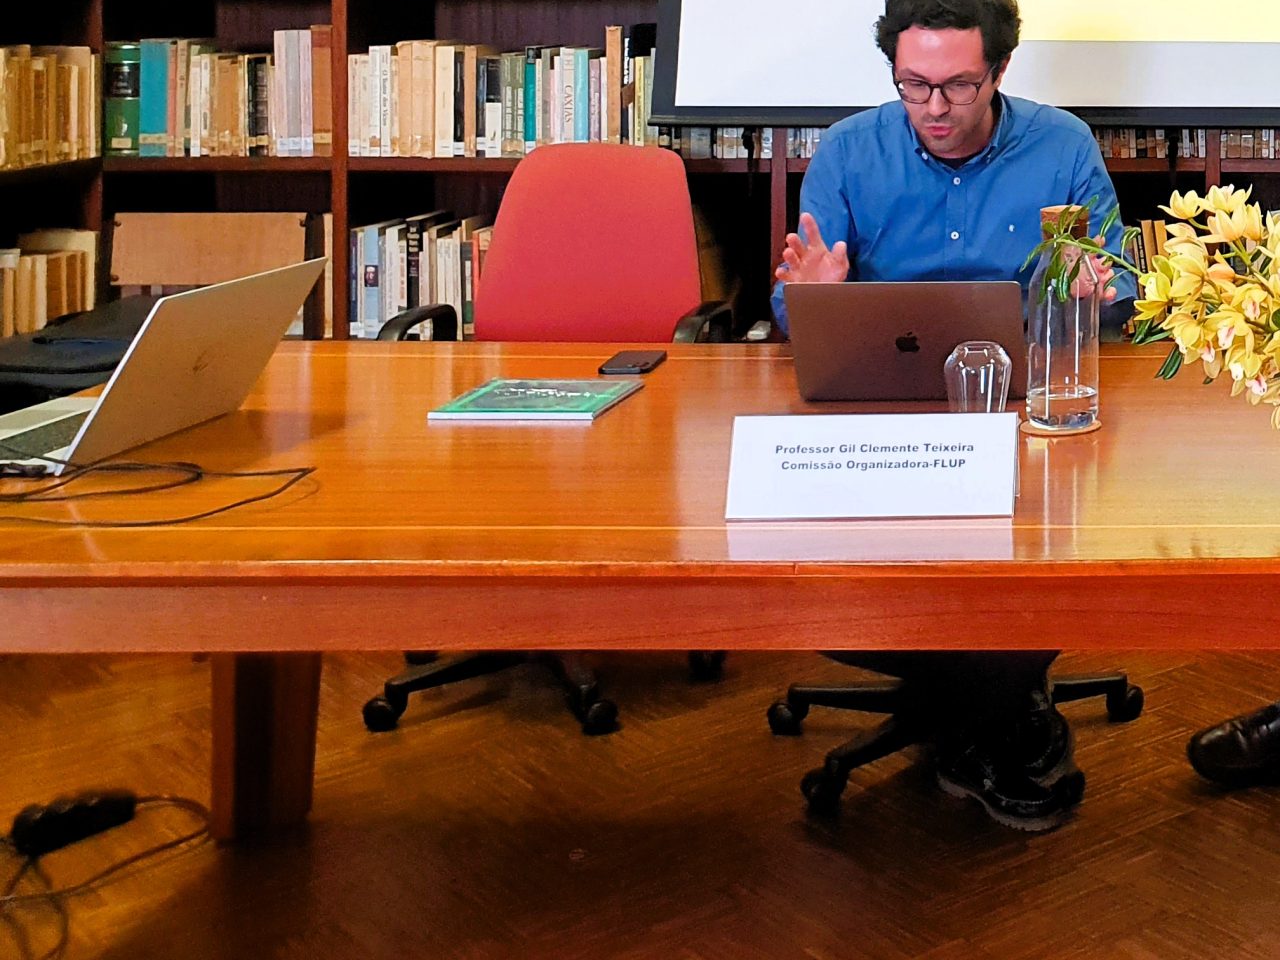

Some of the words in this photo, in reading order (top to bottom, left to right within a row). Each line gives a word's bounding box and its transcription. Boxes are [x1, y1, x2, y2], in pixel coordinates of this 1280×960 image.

[564, 85, 573, 123] CAXIAS
[775, 444, 836, 454] Professor
[838, 444, 856, 454] Gil
[859, 443, 920, 453] Clemente
[922, 442, 974, 453] Teixeira
[781, 460, 842, 470] Comissão
[846, 458, 966, 471] Organizadora-FLUP
